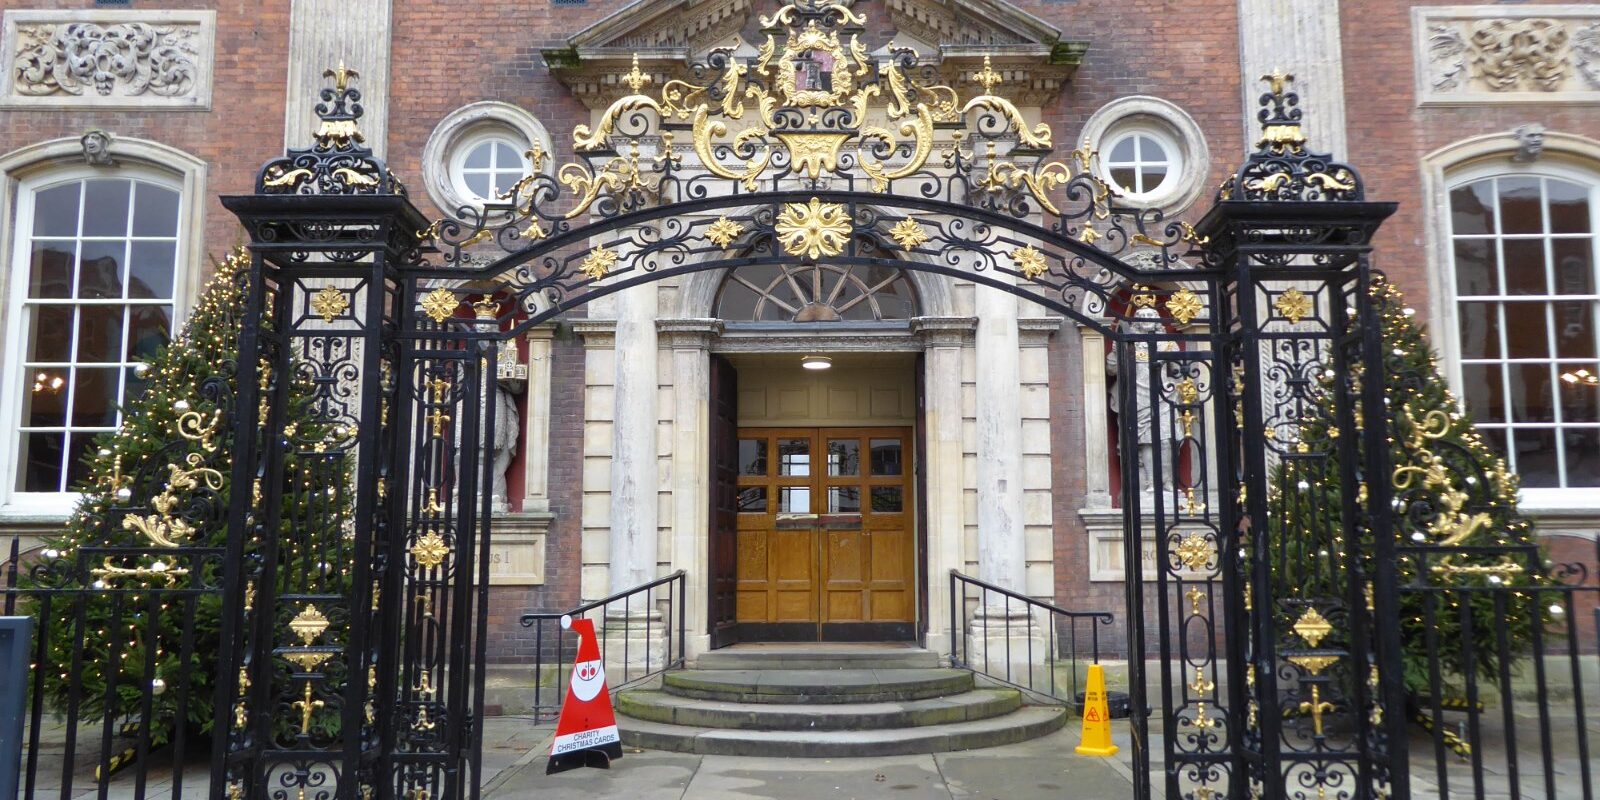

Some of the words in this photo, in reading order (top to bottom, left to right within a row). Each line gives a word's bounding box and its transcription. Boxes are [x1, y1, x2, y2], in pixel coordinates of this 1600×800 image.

[557, 738, 593, 753] CHRISTMAS
[594, 734, 615, 745] CARDS
[573, 730, 600, 742] CHARITY
